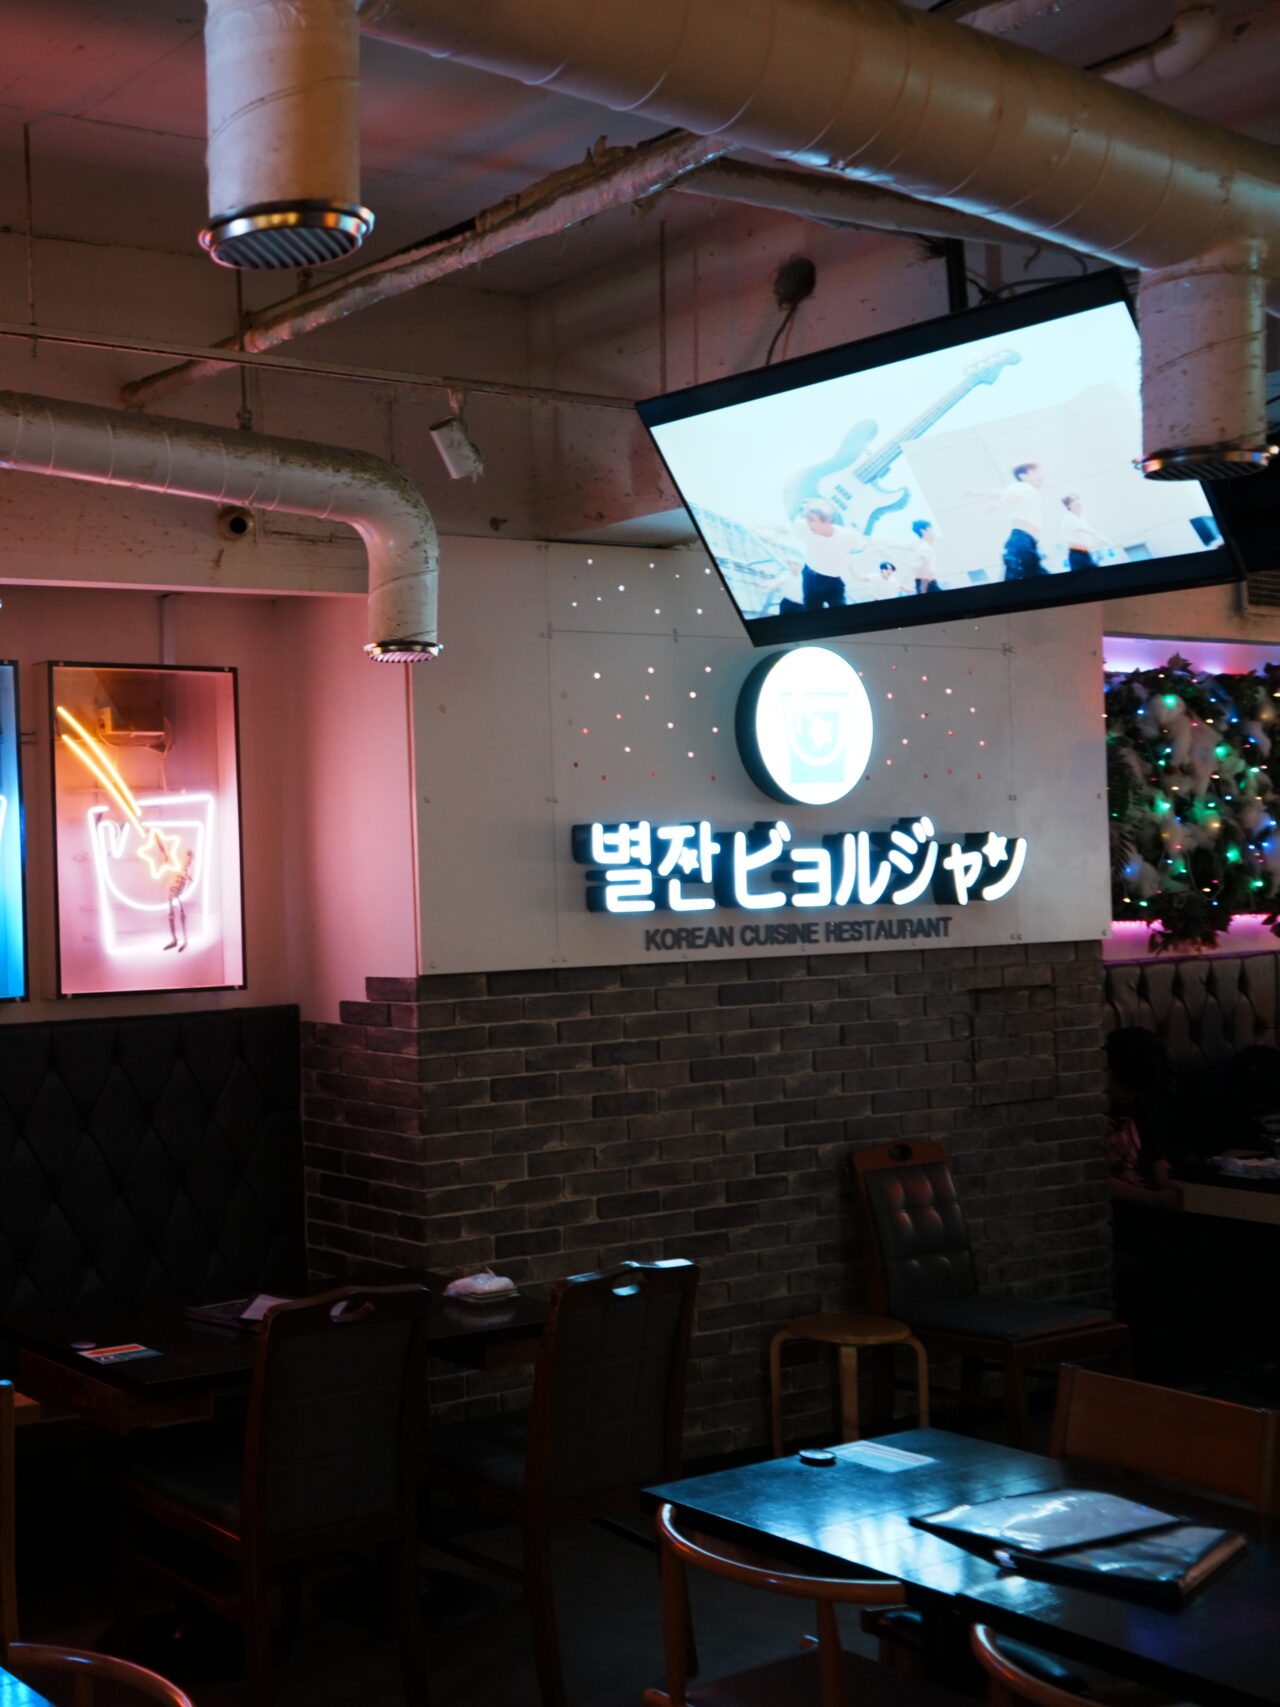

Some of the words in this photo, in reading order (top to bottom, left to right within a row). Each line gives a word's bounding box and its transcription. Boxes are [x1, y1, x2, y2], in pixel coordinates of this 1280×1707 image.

[591, 820, 721, 913] 별잔
[733, 816, 1028, 910] ビョルジャン
[644, 925, 735, 951] KOREAN
[740, 922, 819, 947] CUISINE
[825, 916, 952, 943] RESTAURANT
